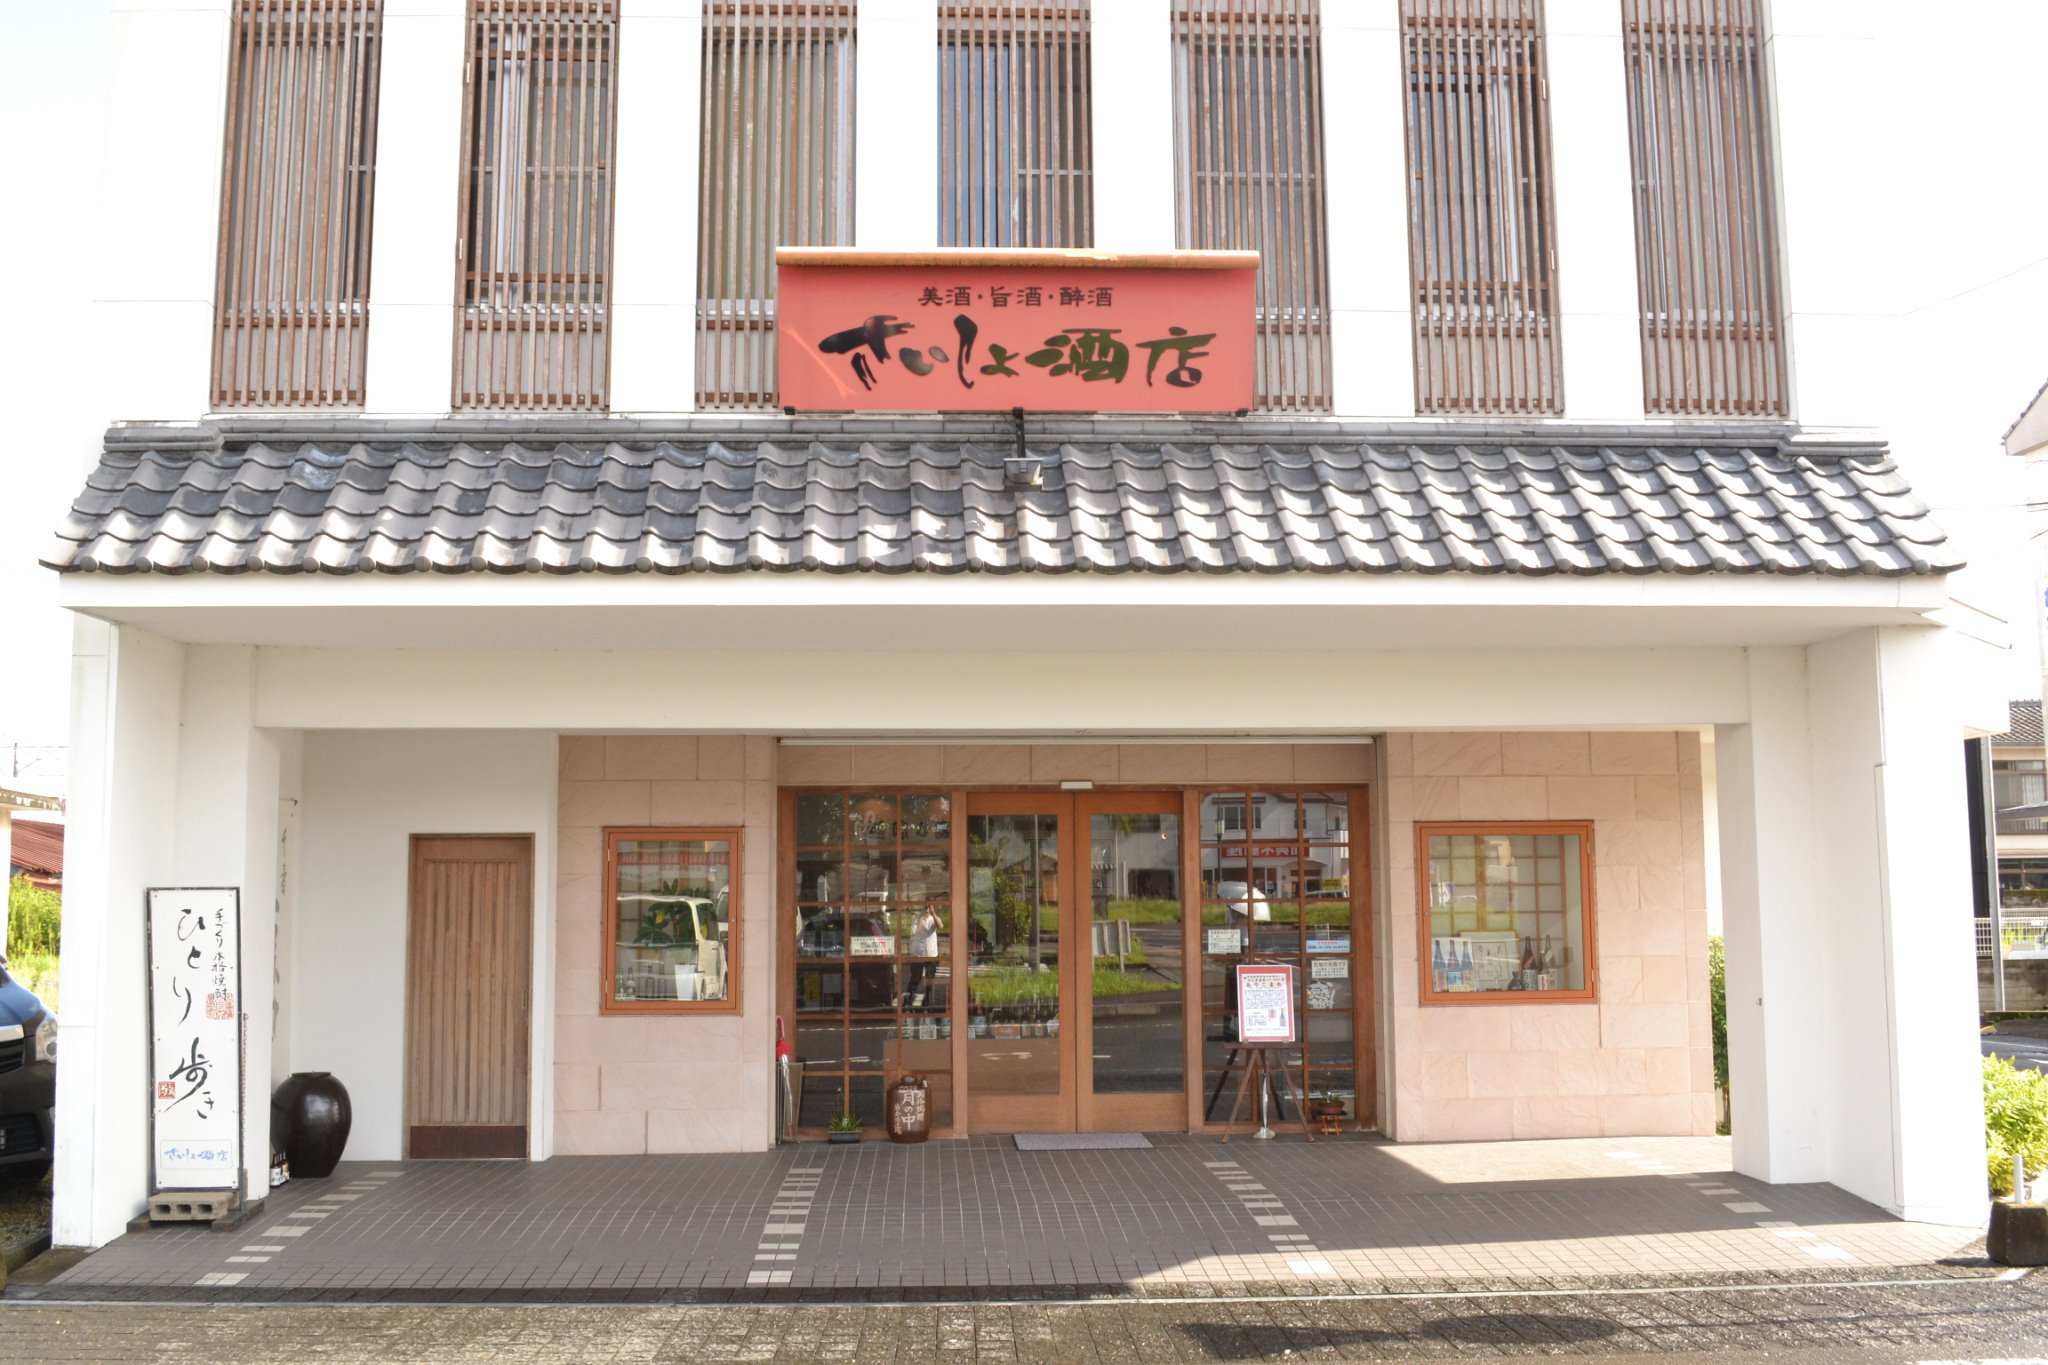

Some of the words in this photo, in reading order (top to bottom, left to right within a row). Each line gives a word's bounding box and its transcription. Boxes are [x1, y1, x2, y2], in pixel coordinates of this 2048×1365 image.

[164, 908, 214, 1119] ひとり歩き
